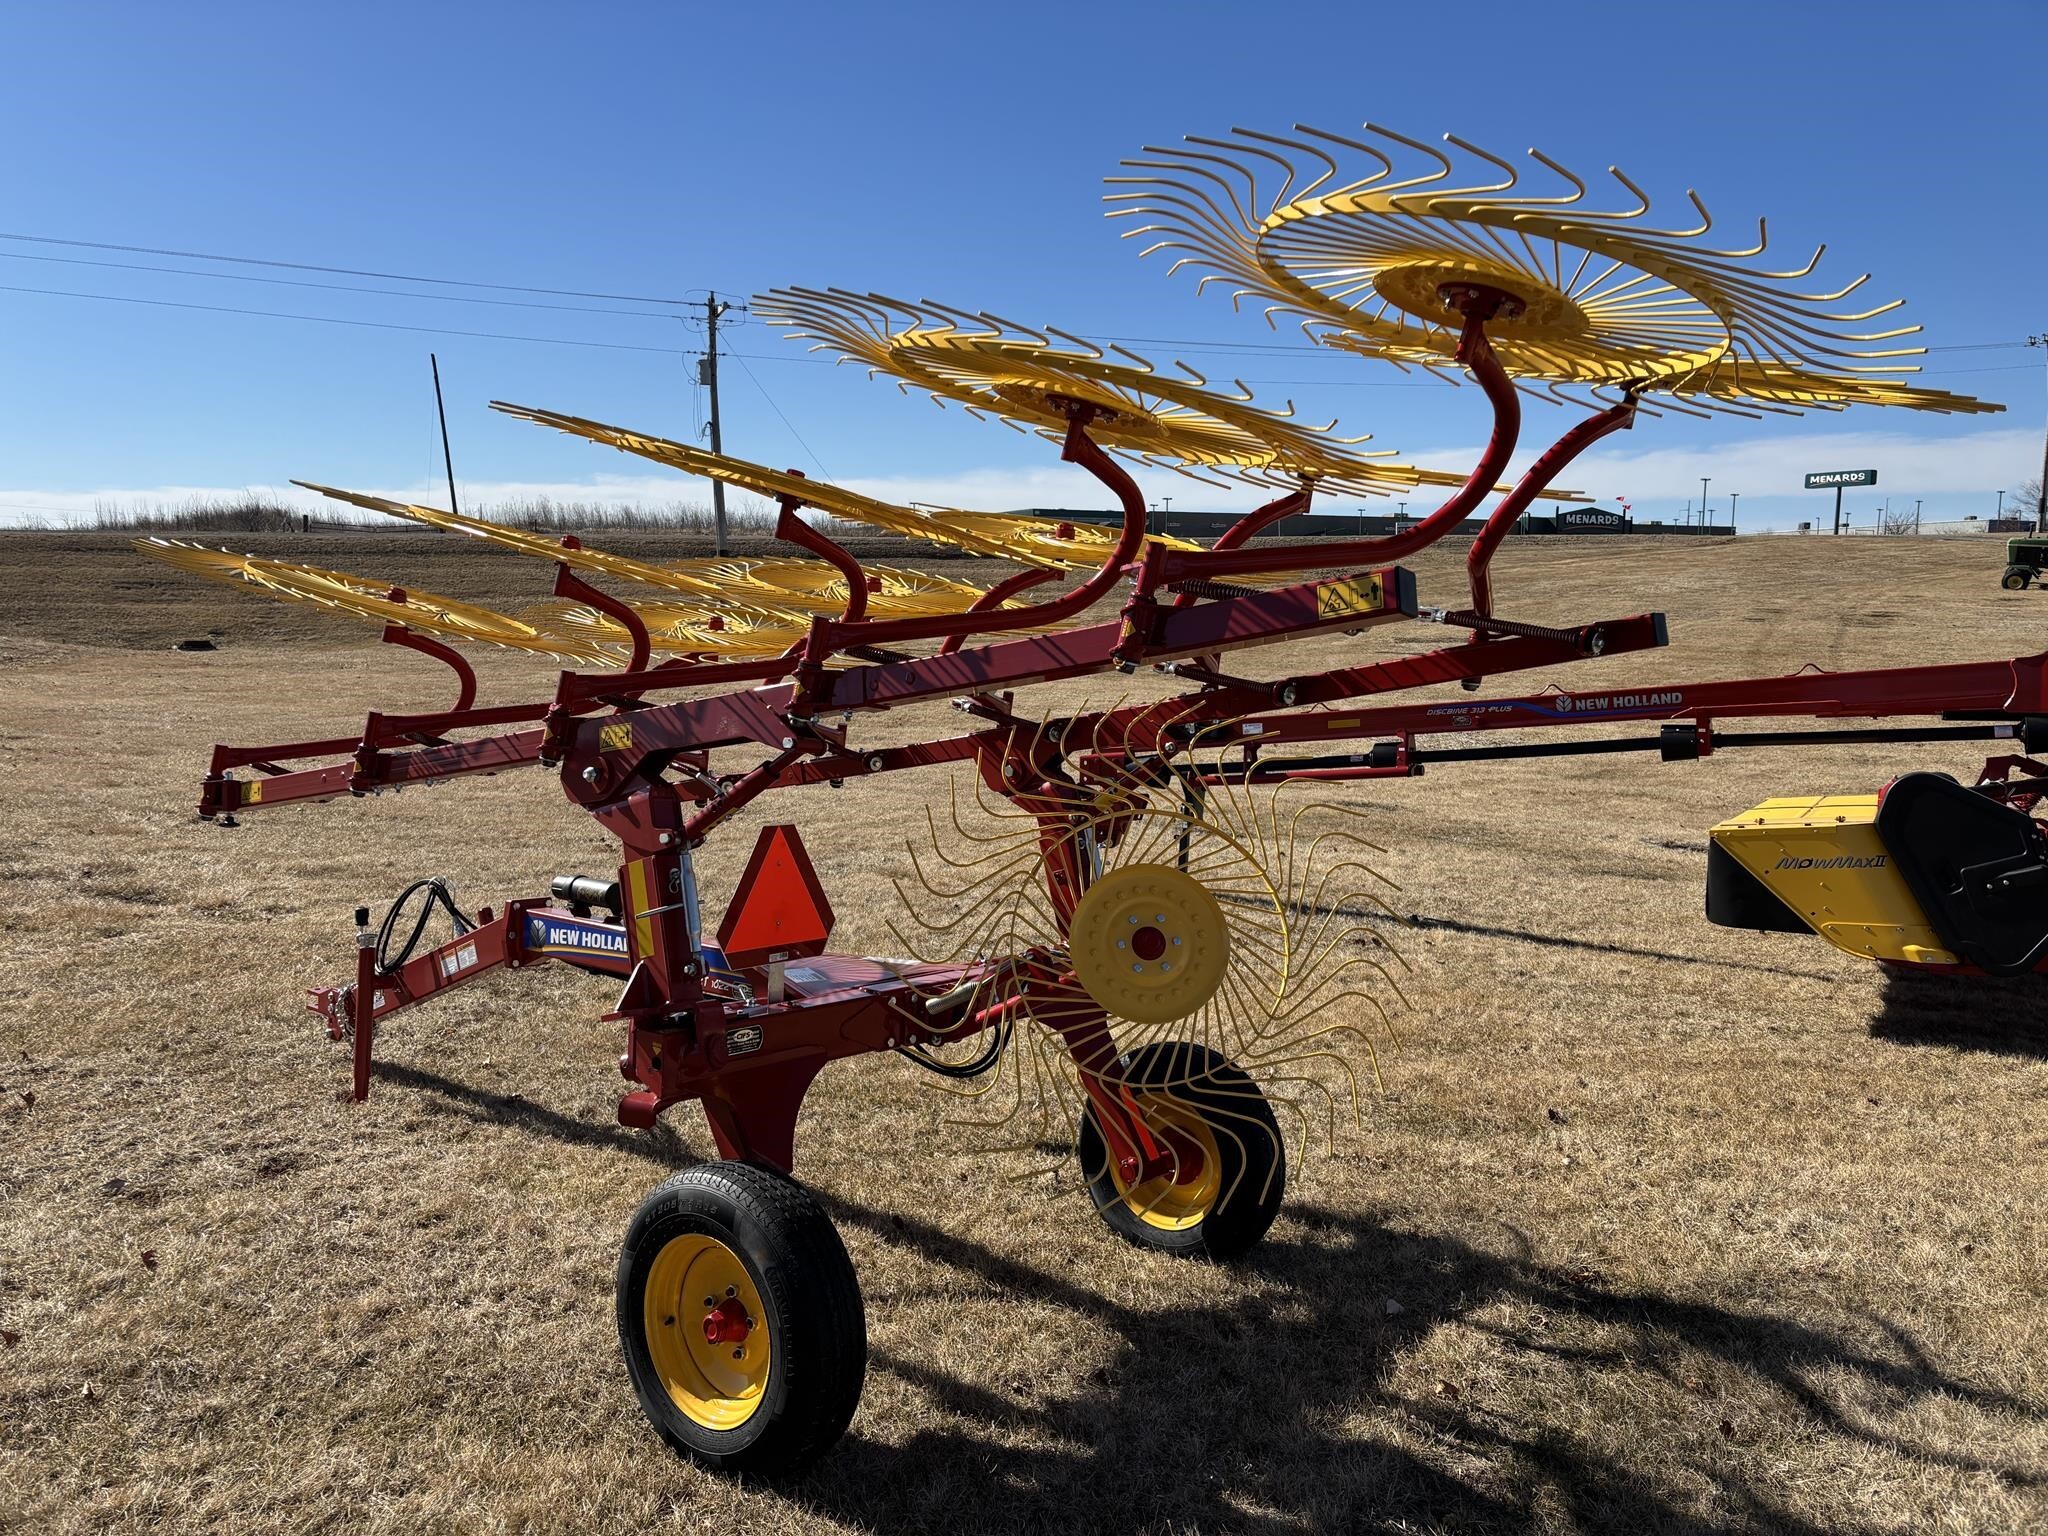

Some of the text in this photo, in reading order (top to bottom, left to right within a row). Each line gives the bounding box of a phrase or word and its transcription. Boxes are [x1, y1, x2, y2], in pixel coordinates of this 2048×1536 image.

[1809, 472, 1866, 484] MENARDS
[1566, 514, 1619, 525] MENARDS
[1575, 692, 1683, 711] NEW HOLLAND
[1426, 706, 1468, 716] DISCBINE
[1488, 705, 1513, 713] PLUS
[550, 928, 580, 946] NEW
